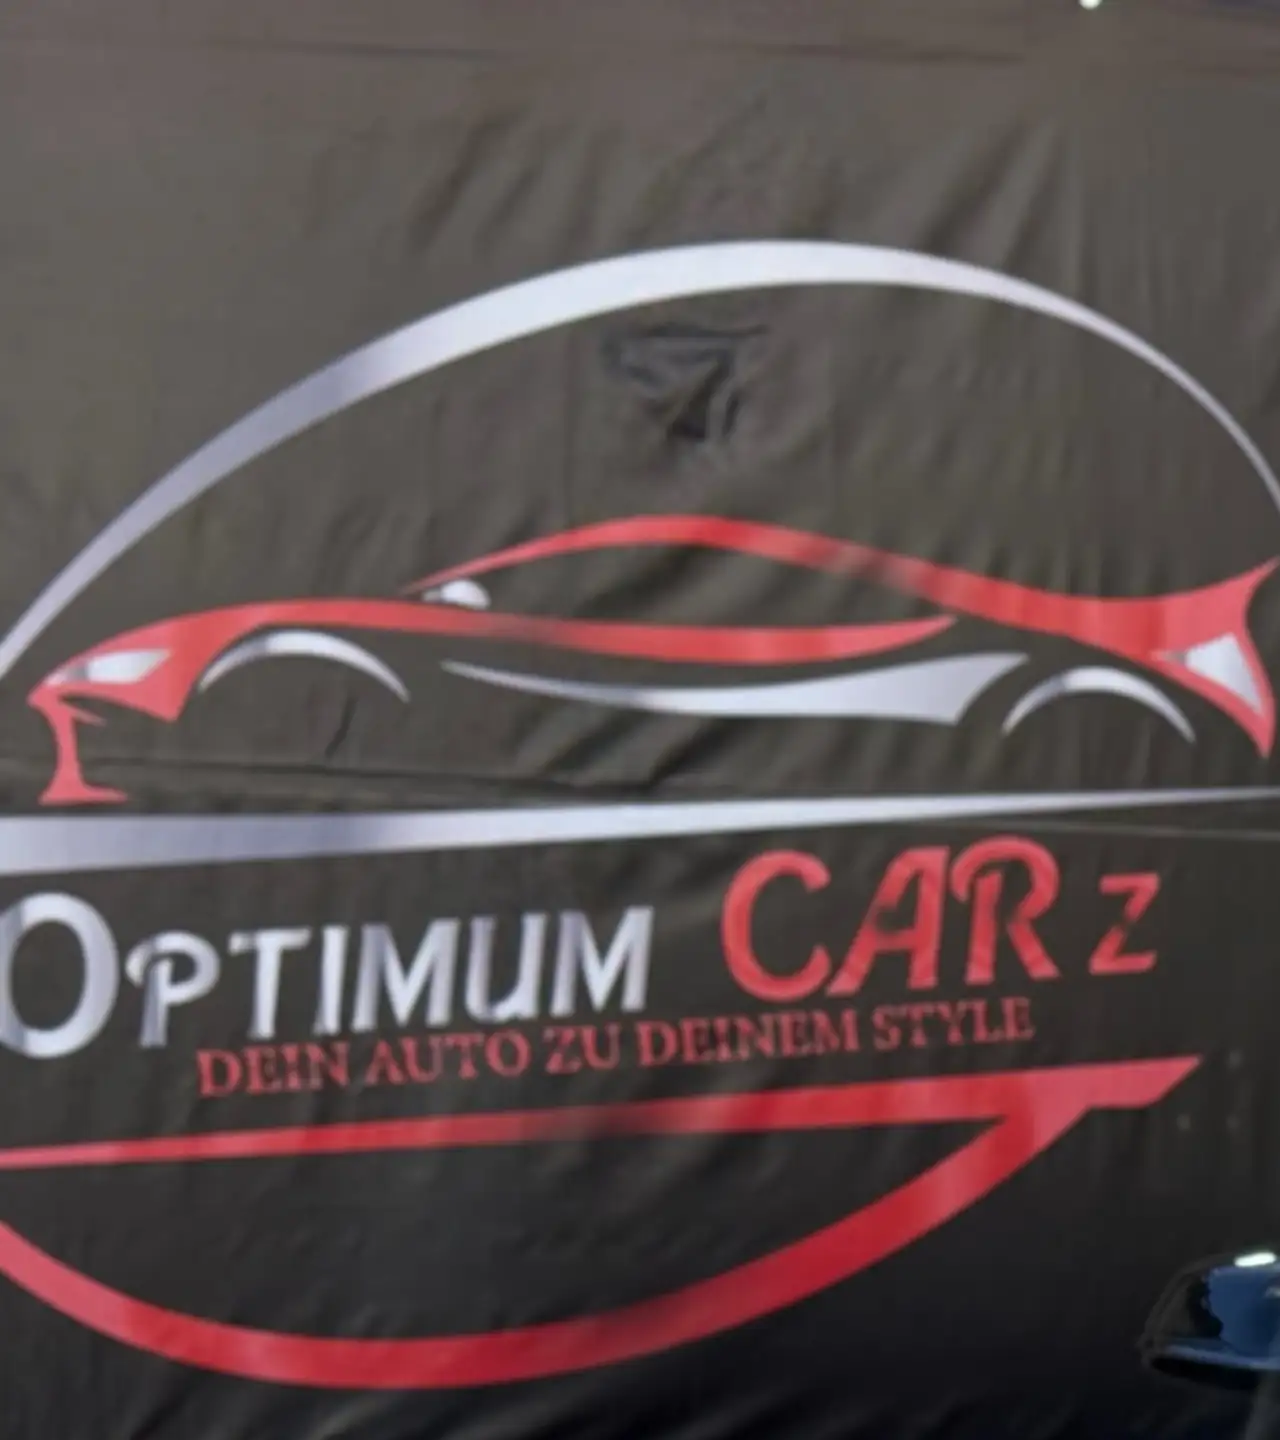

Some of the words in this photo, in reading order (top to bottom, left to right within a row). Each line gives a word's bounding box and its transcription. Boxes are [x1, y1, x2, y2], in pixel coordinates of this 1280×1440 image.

[721, 836, 1062, 1003] CAR
[196, 1040, 350, 1097] DEIN
[364, 1028, 532, 1087] AUTO
[543, 1022, 621, 1076] ZU
[636, 1008, 859, 1068] DEINEM
[872, 996, 1036, 1051] STYLE
